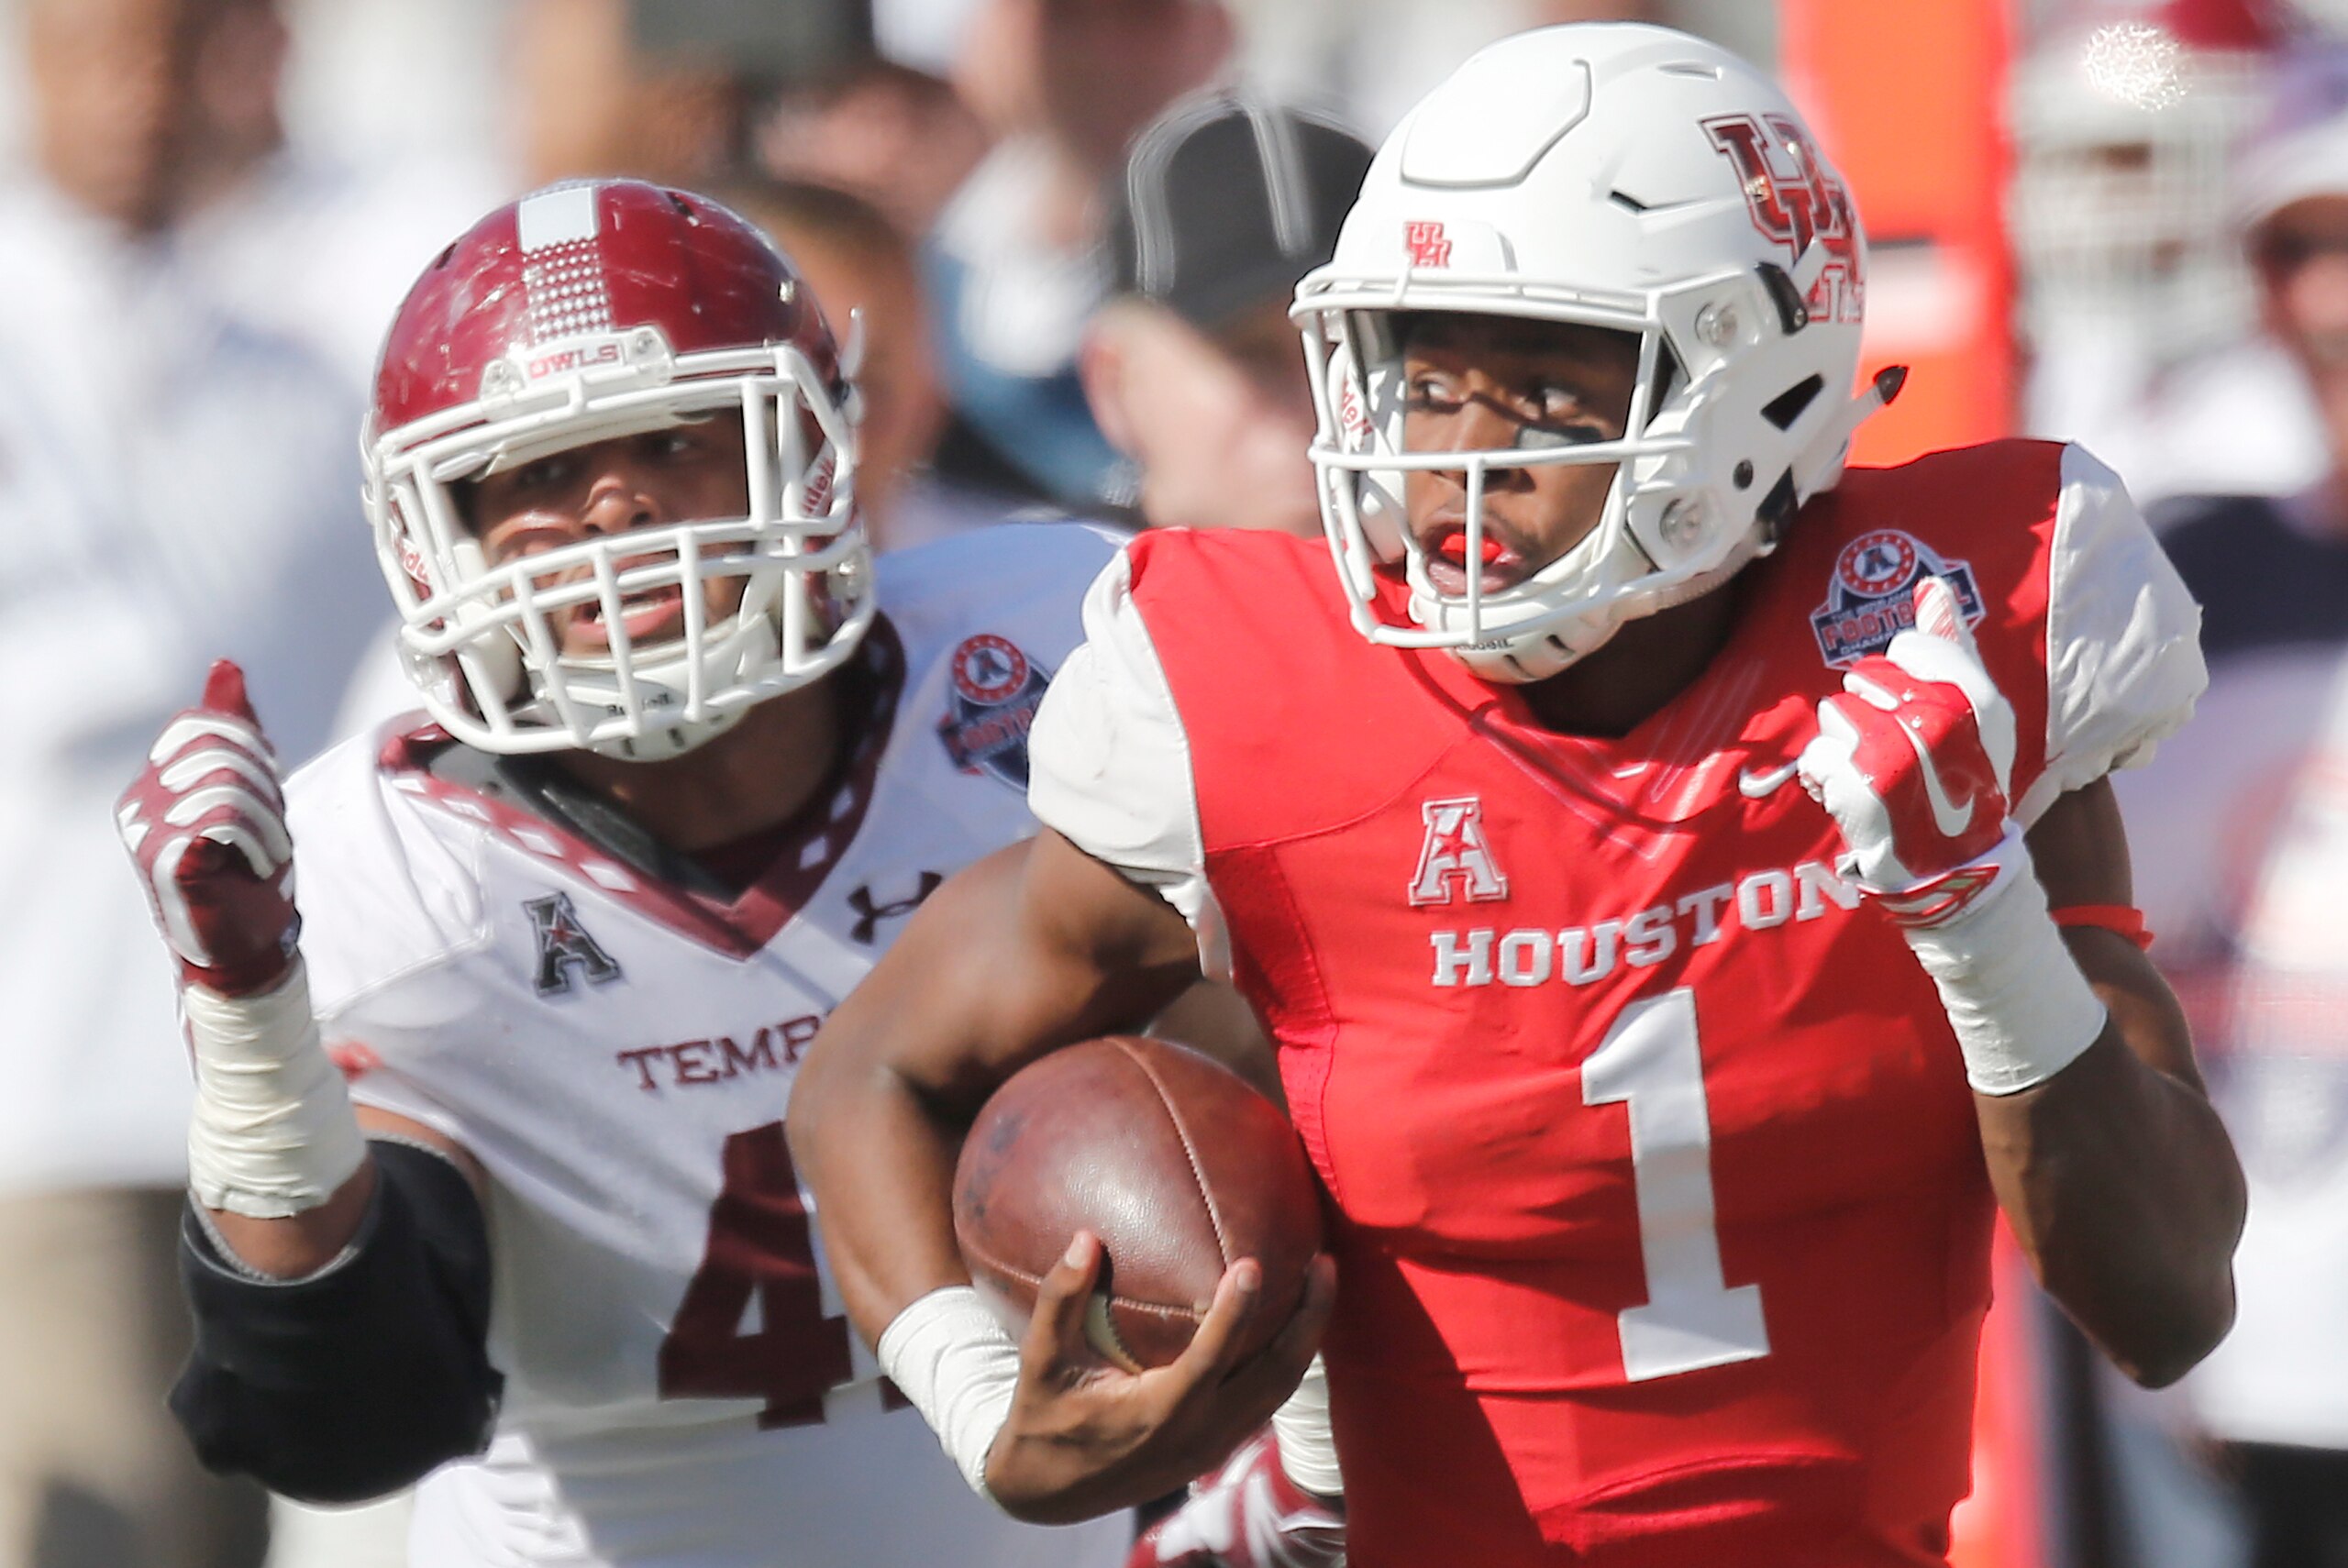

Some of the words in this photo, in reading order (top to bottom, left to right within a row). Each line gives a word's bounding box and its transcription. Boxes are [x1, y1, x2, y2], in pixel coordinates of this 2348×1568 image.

[528, 345, 619, 379] OWLS
[1820, 580, 1973, 652] FOOTBL
[1408, 797, 1508, 906] A
[521, 890, 624, 998] A
[1430, 854, 1861, 988] HOUSTON
[617, 1011, 830, 1090] TEMP
[1581, 987, 1771, 1382] 1
[658, 1121, 913, 1431] 4
